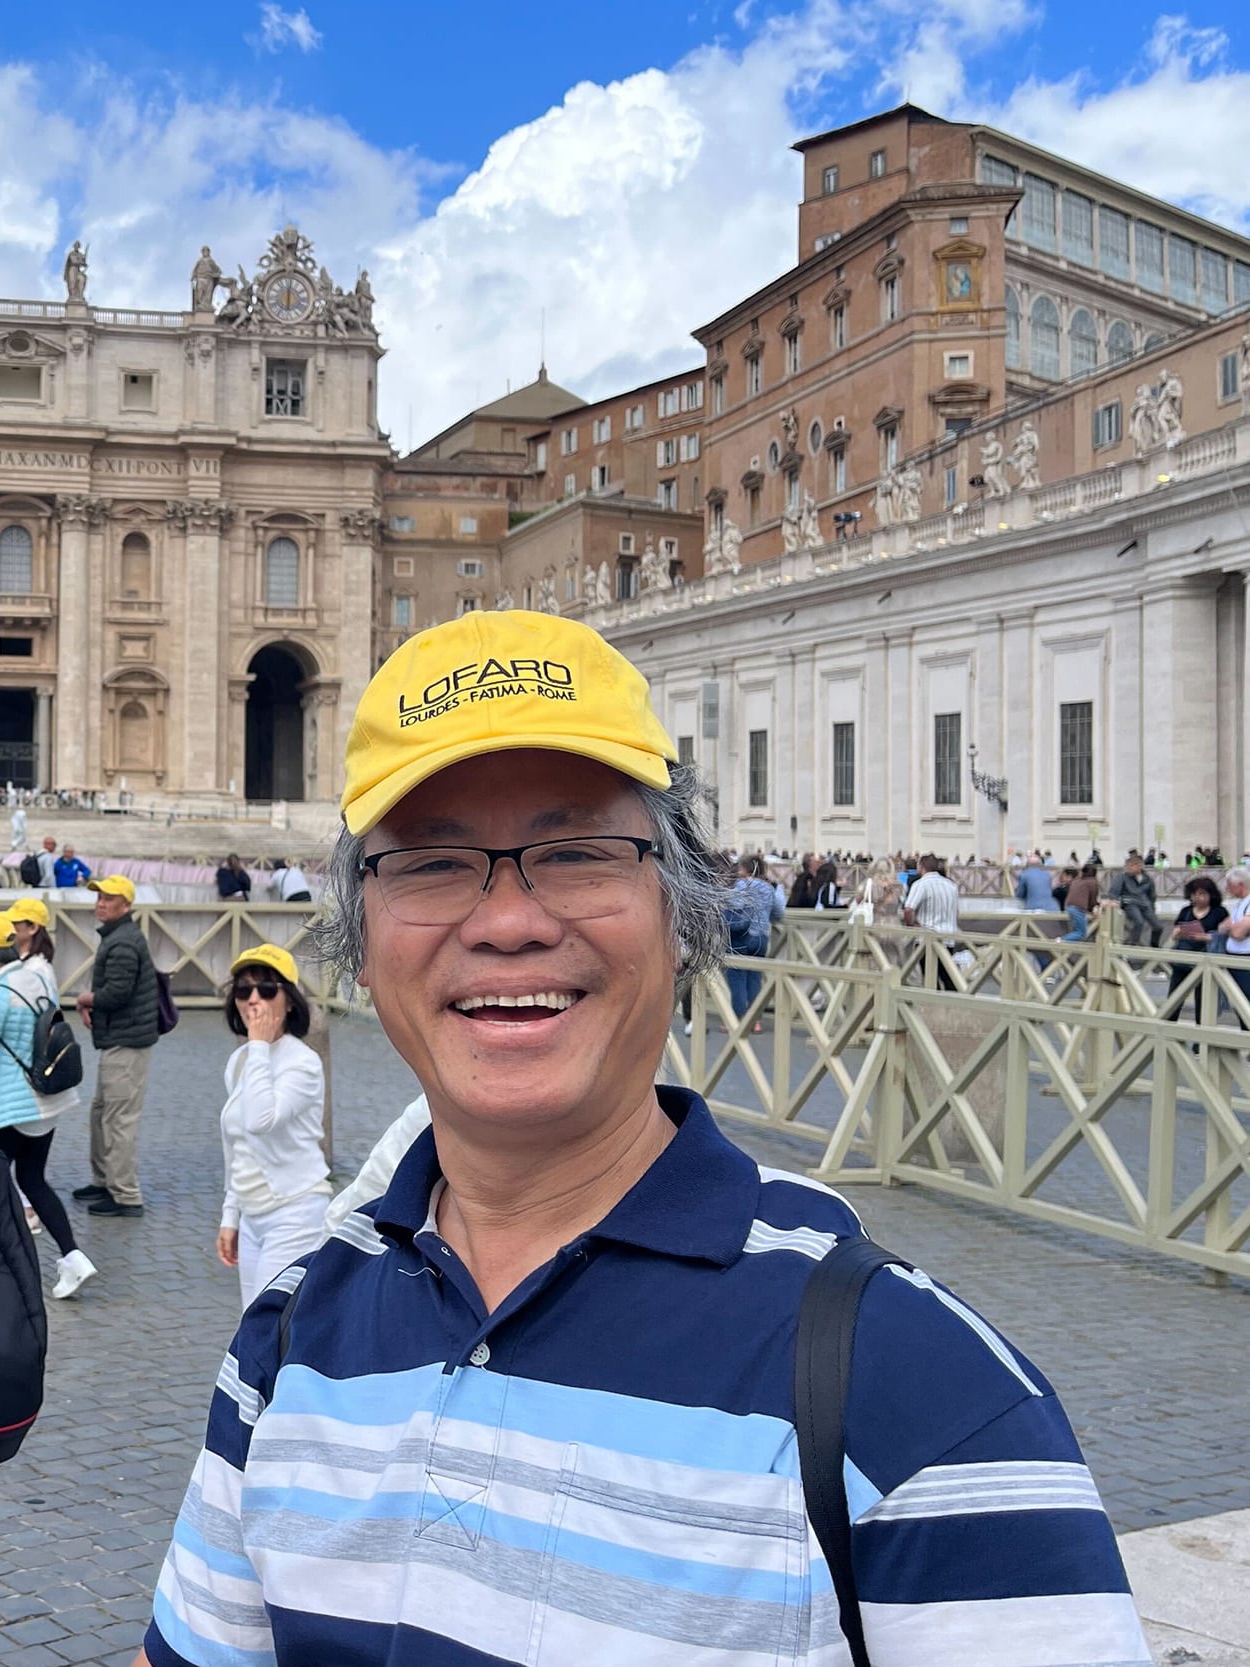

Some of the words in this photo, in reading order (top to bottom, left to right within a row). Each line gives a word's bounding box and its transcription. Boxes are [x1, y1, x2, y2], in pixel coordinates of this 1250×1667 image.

[399, 658, 573, 714] LOFARO
[399, 699, 460, 728] LOURDES
[470, 684, 527, 703] FATIMA
[537, 685, 577, 701] ROME
